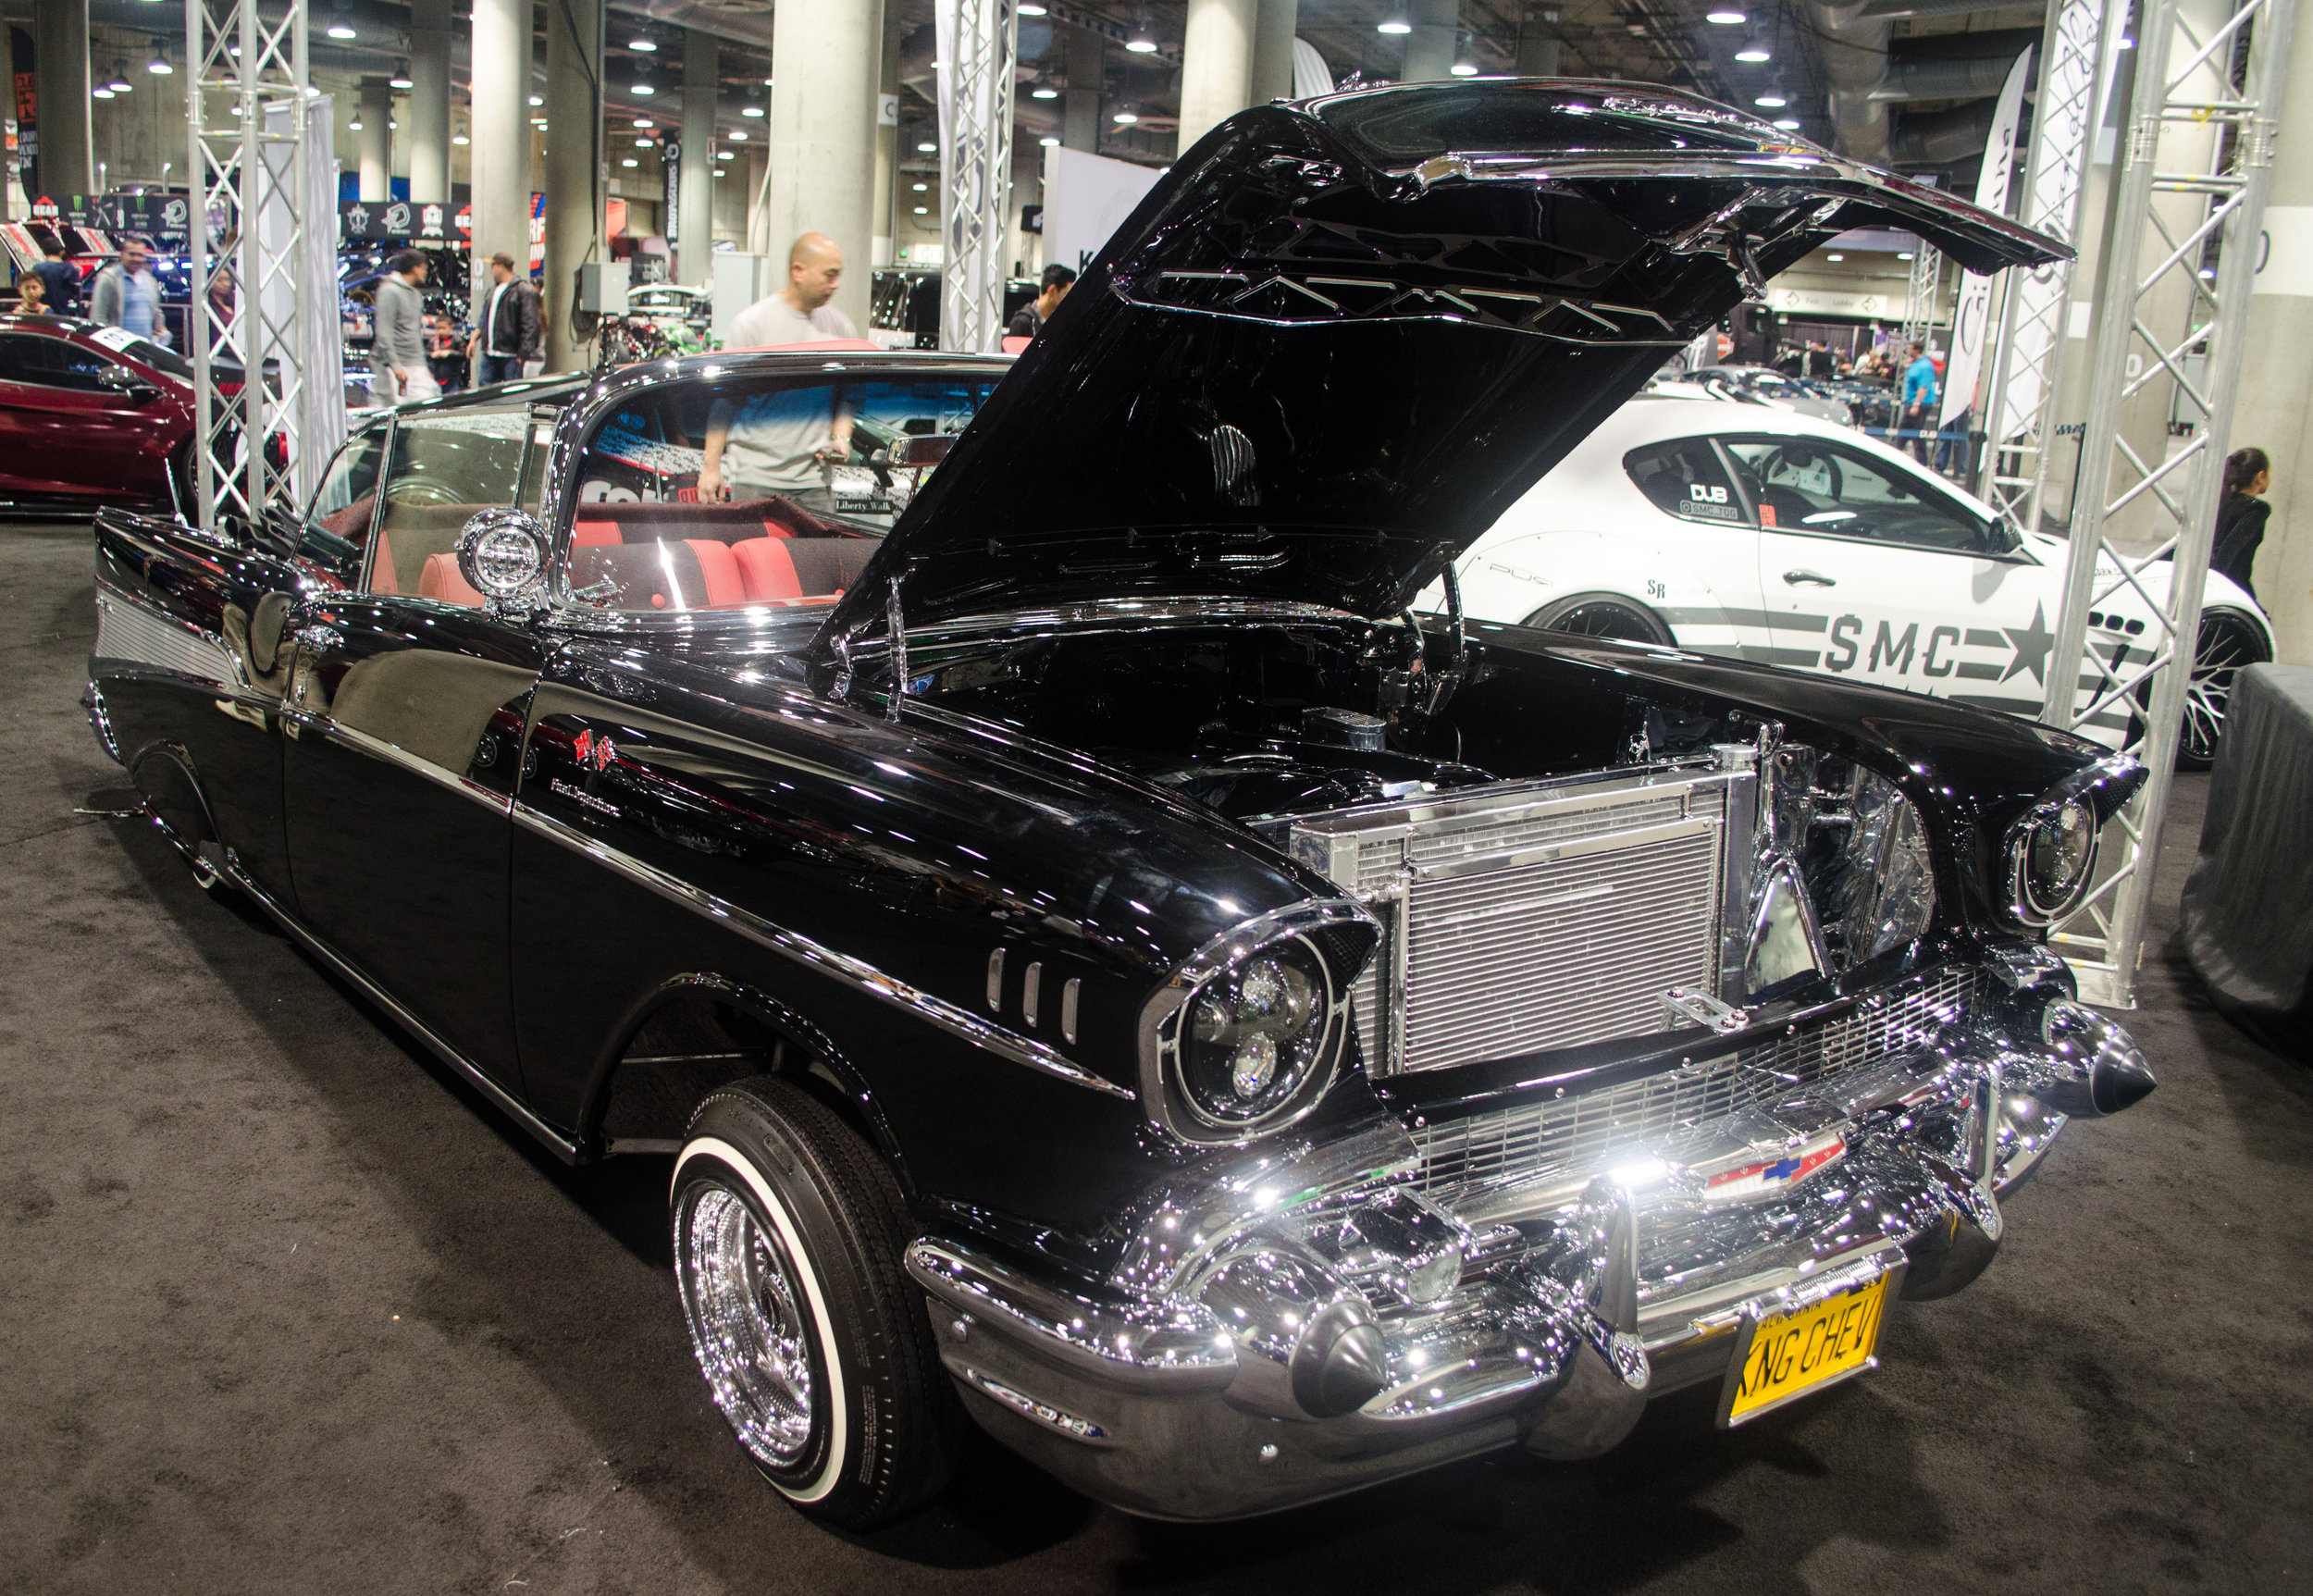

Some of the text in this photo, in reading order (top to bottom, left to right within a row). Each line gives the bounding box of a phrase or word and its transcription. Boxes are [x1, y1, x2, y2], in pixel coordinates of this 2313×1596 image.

[1690, 484, 1727, 503] DUB
[835, 500, 891, 513] Liberty Walk
[1801, 1293, 1880, 1374] CHEV
